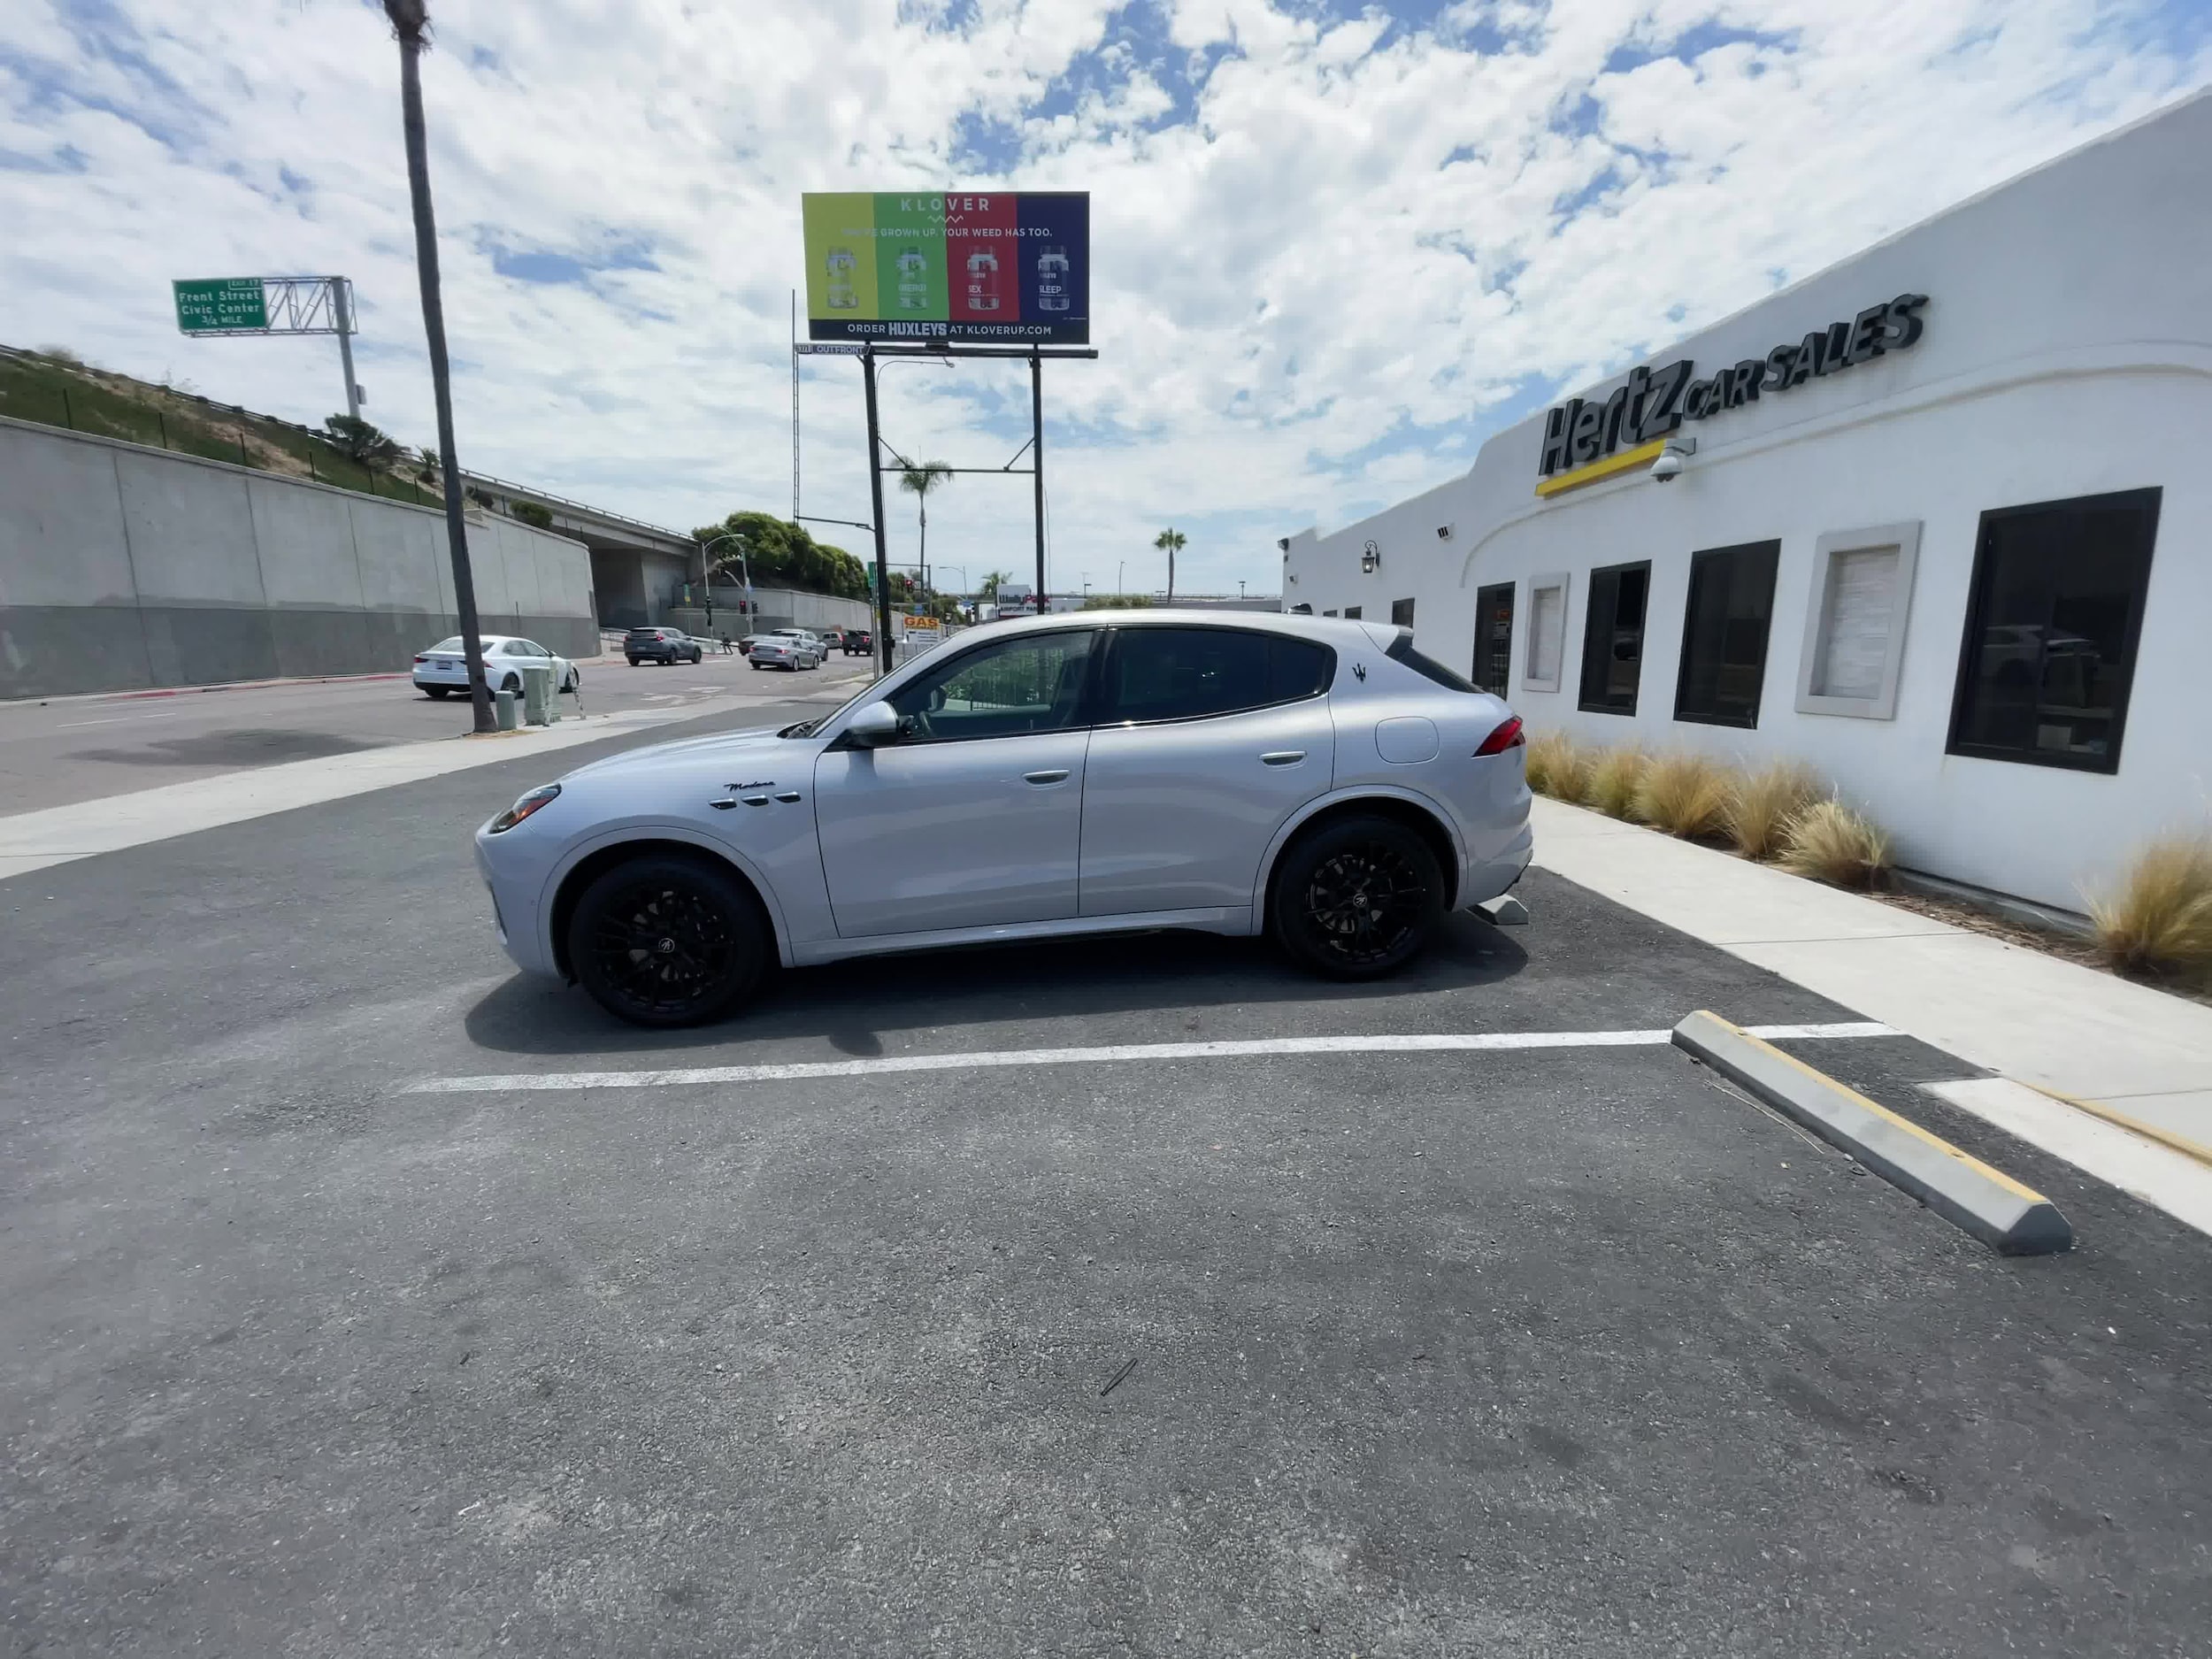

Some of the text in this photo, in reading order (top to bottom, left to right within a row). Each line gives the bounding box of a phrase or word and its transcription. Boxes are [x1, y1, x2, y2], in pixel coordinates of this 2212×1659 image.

[901, 197, 990, 211] KLOVER
[880, 228, 920, 237] GROWN
[941, 227, 969, 237] YOUR
[972, 227, 1002, 237] WEED
[1005, 227, 1025, 237] HAS
[1028, 227, 1053, 237] TOO.
[968, 284, 982, 294] SEX
[1039, 285, 1062, 294] SLEEP
[179, 290, 259, 302] Front Street
[181, 303, 260, 315] Civic Center
[220, 315, 243, 324] MILE
[847, 322, 1052, 336] ORDER HUXLEYS AT KLOVERUP.COM
[816, 345, 864, 354] OUTFRONT
[1539, 293, 1930, 476] Hertz CAR SALES
[904, 617, 939, 627] GAS
